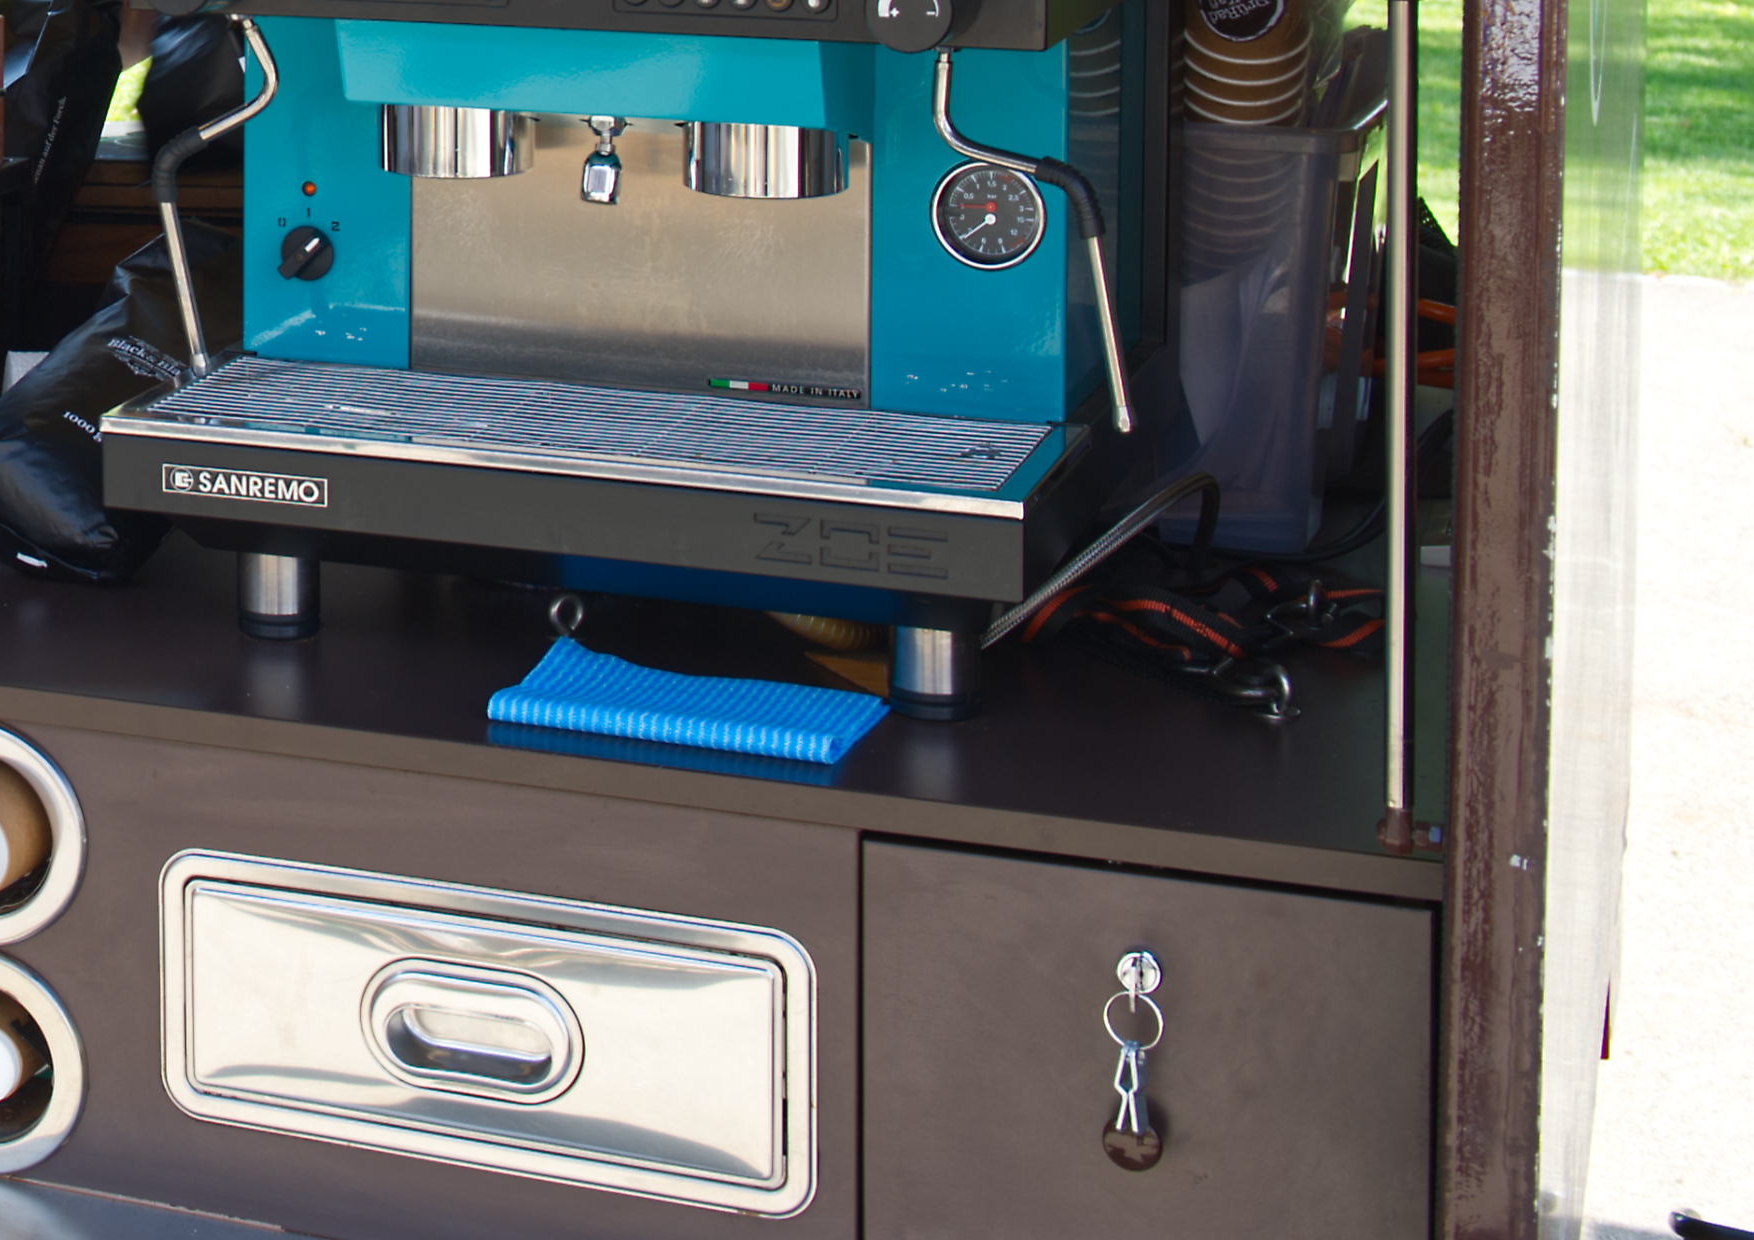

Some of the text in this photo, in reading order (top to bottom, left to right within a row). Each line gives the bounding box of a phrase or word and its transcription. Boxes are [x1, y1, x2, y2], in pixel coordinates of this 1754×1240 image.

[107, 337, 146, 358] Black
[771, 383, 861, 399] MADE IN ITALY
[62, 410, 96, 434] 1000
[198, 470, 320, 503] SANREMO
